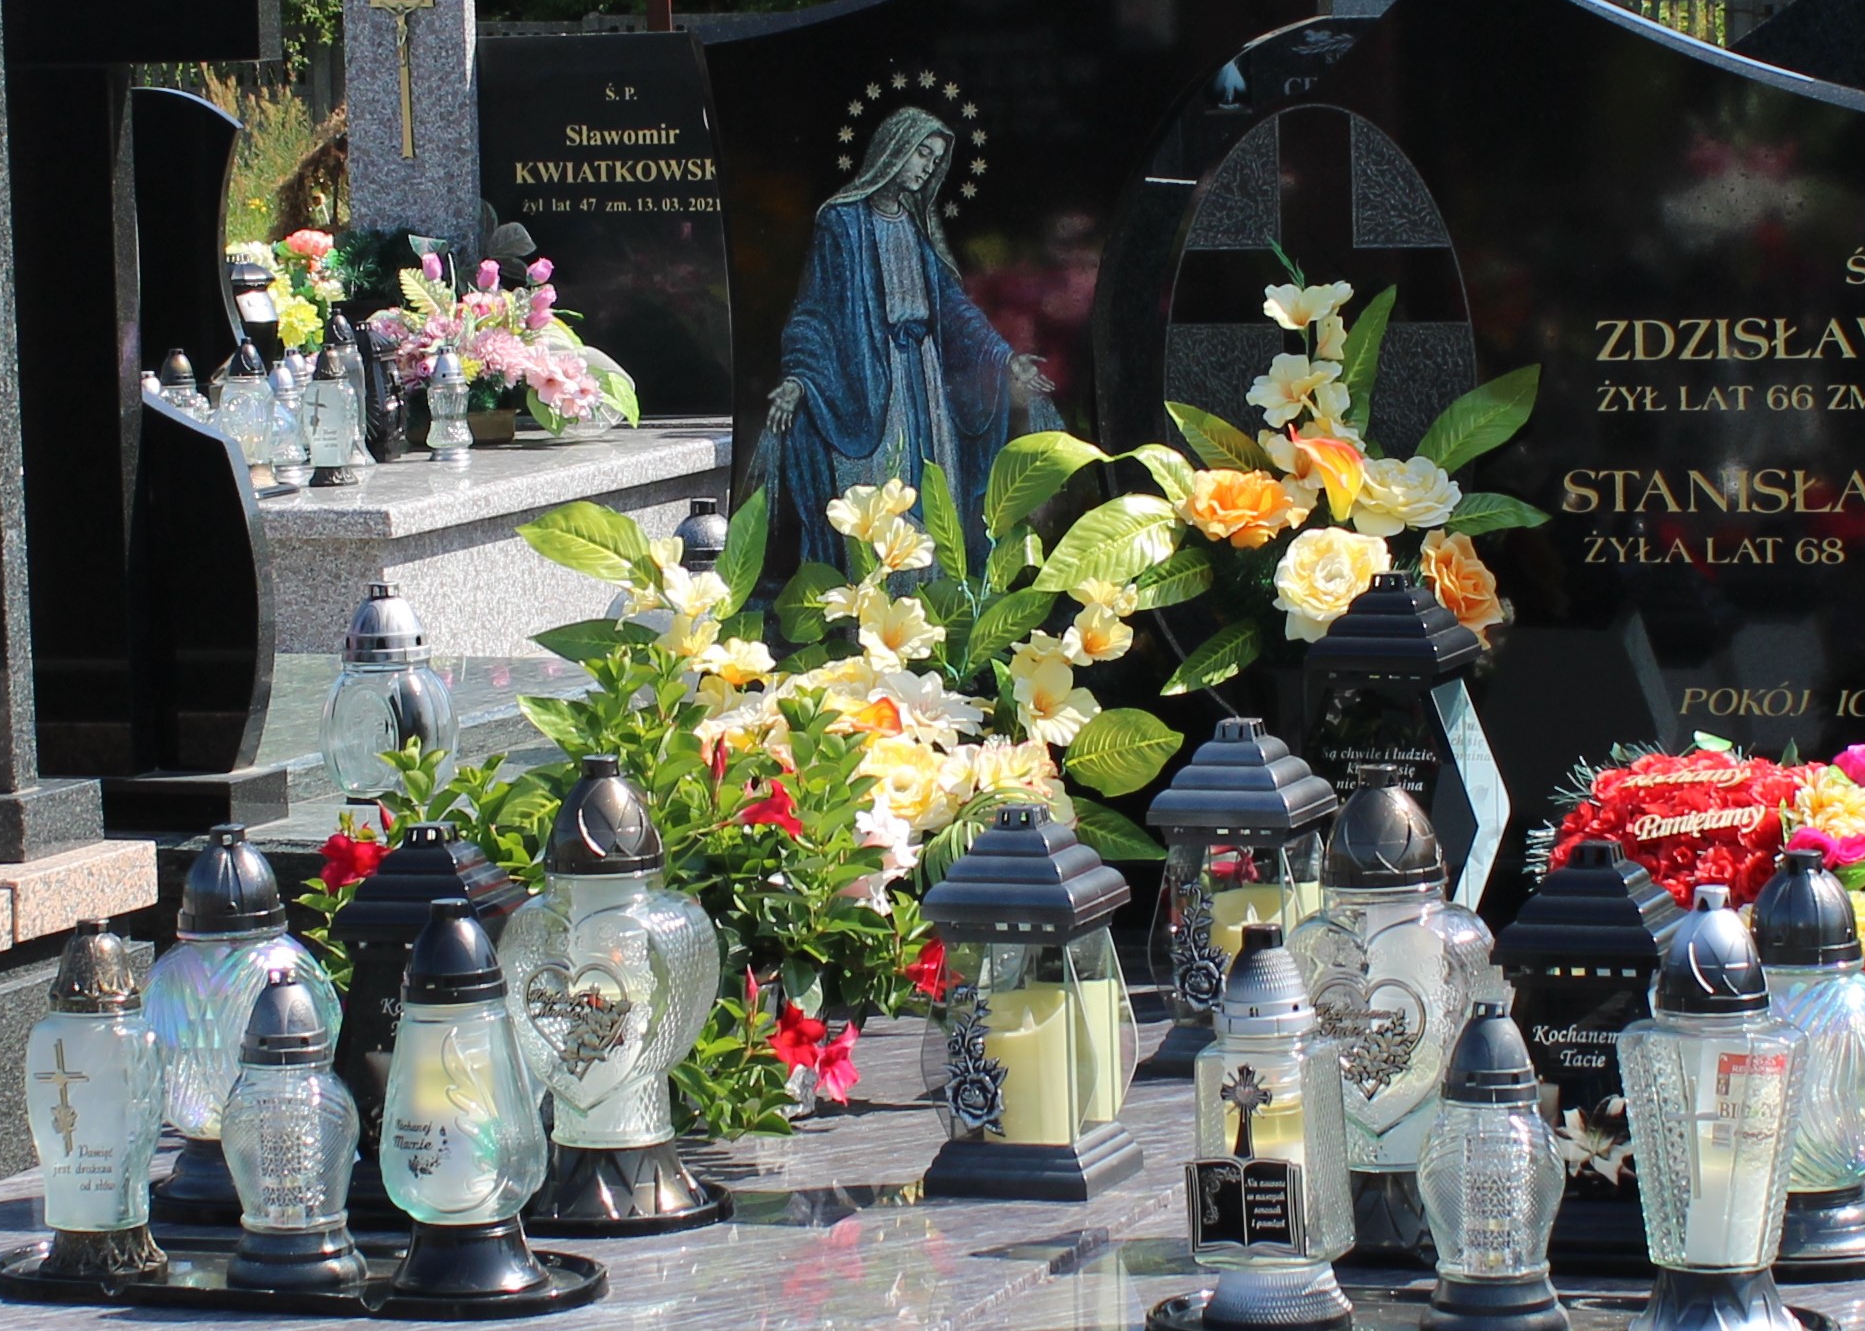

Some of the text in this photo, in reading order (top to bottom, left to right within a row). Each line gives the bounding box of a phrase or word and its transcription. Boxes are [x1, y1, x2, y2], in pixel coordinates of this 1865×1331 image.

[565, 124, 680, 146] Sławomir
[552, 198, 570, 212] lat
[580, 198, 597, 212] 47
[605, 201, 631, 212] zm.
[637, 197, 657, 212] 13.
[662, 197, 684, 212] 03.
[1597, 379, 1667, 412] ŻYŁ
[1679, 385, 1754, 411] LAT
[1766, 384, 1815, 411] 66
[1584, 530, 1693, 564] ŻYŁA
[1706, 537, 1783, 564] LAT
[1795, 537, 1845, 565] 68
[1679, 681, 1811, 718] POKÓJ
[1340, 746, 1381, 761] chwile
[1392, 747, 1436, 762] ludzie,
[1634, 804, 1767, 841] Pamiętamy
[1560, 1049, 1606, 1068] Tacie
